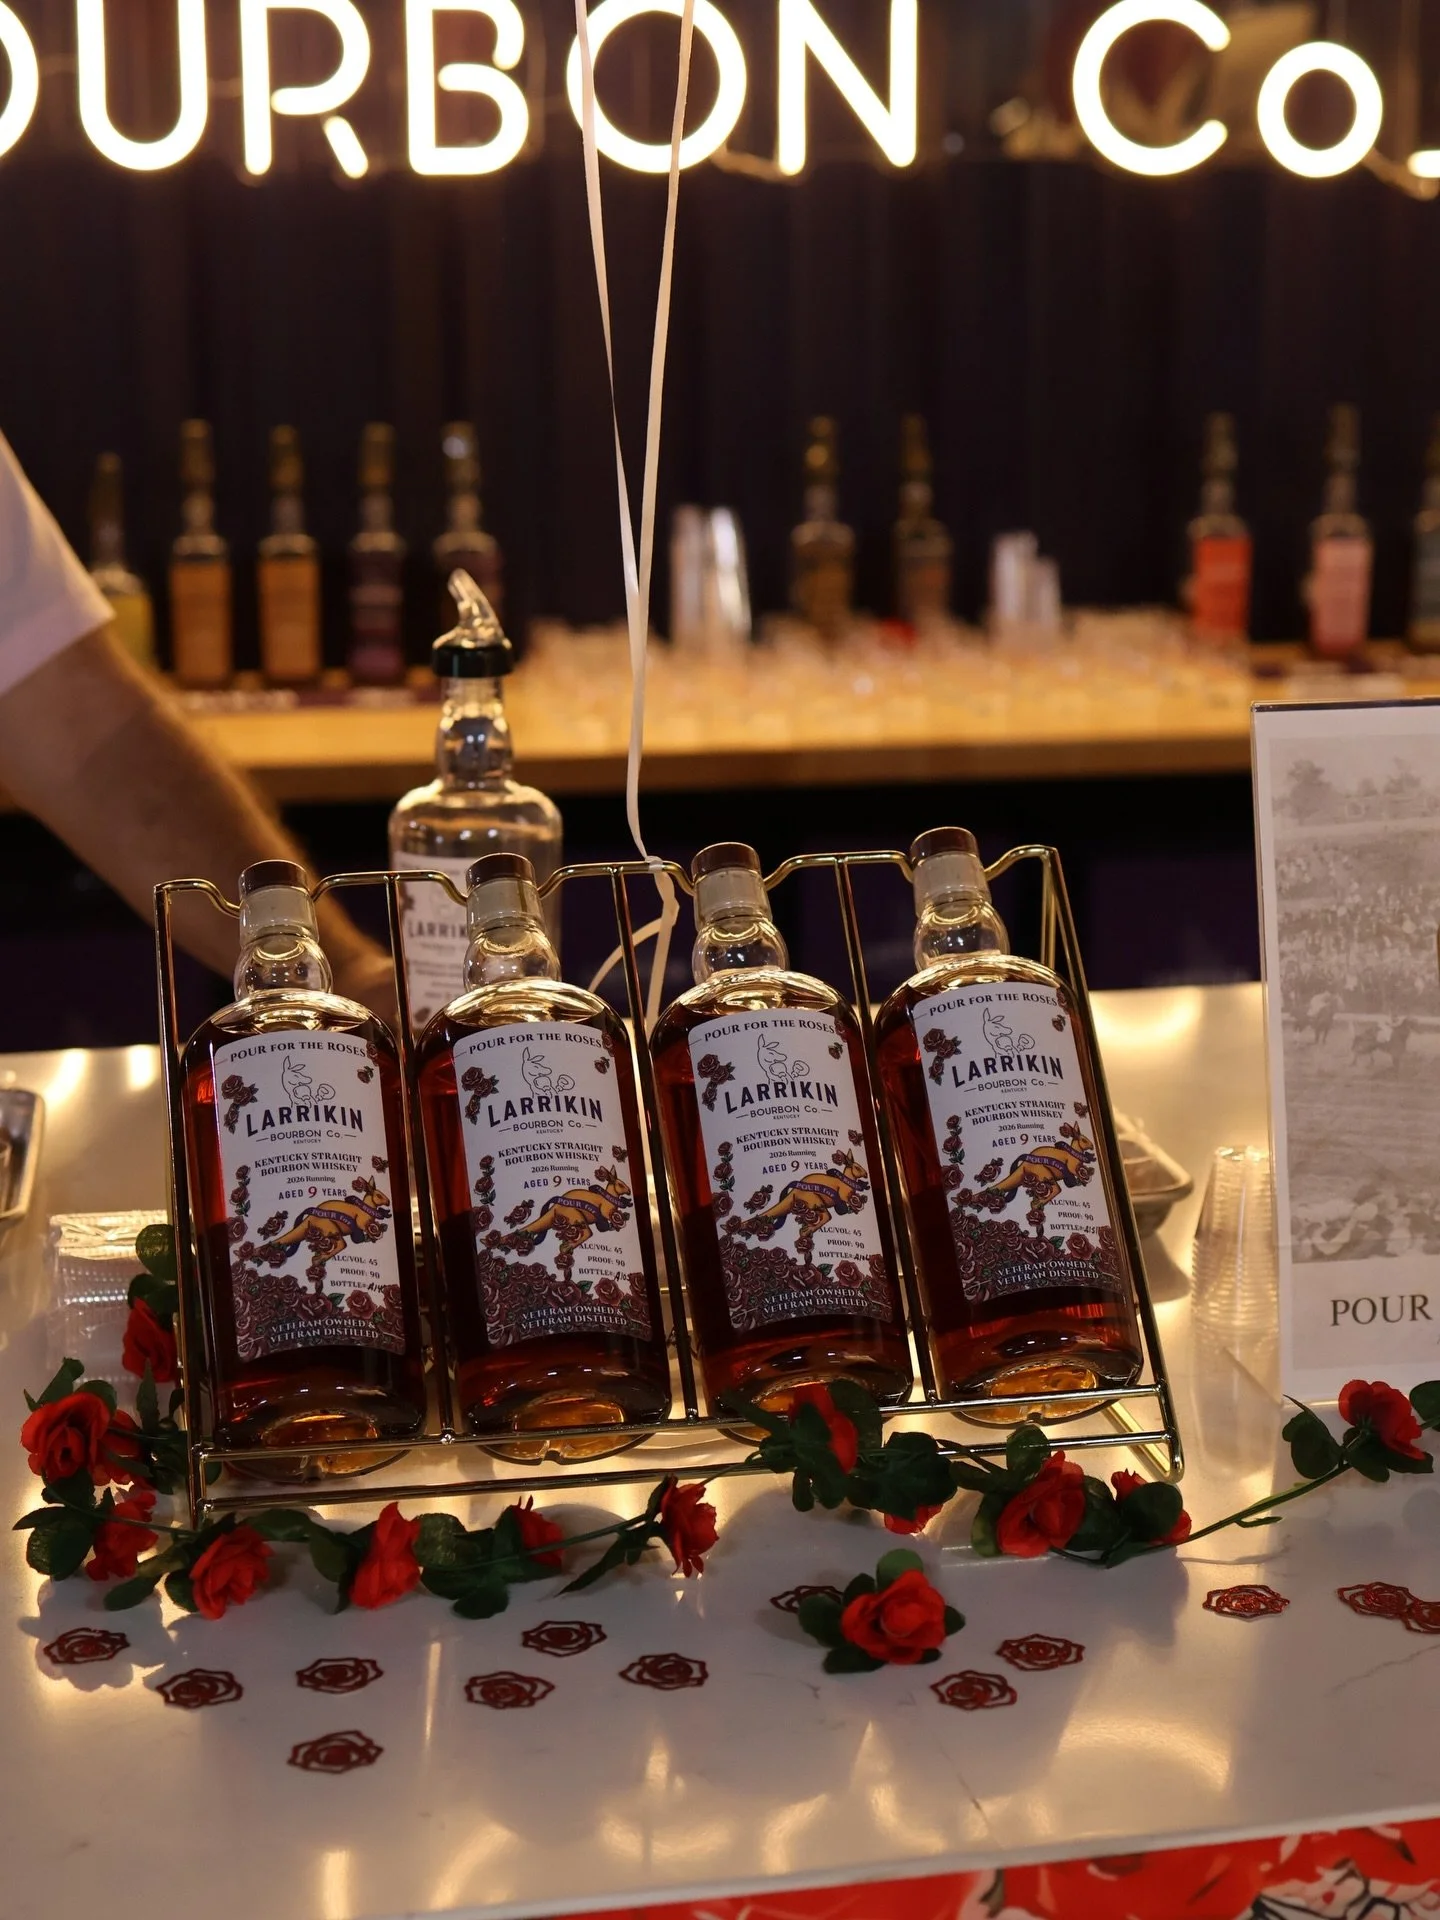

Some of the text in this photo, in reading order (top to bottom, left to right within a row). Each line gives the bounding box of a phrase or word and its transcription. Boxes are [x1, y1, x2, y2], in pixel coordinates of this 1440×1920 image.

[0, 0, 918, 178] URBON
[929, 993, 1057, 1017] POUR FOR THE ROSES
[704, 1019, 835, 1042] POUR FOR THE ROSES
[469, 1033, 602, 1054] POUR FOR THE ROSES
[230, 1042, 366, 1062] POUR FOR THE ROSES
[951, 1054, 1064, 1088] LARRIKIN
[977, 1079, 1047, 1092] BOURBON Co.
[725, 1081, 838, 1114] LARRIKIN
[488, 1095, 603, 1128] LARRIKIN
[750, 1105, 820, 1118] BOURBON Co.
[965, 1100, 1066, 1118] KENTUCKY STRAIGHT
[246, 1105, 363, 1137] LARRIKIN
[972, 1109, 1063, 1126] BOURBON WHISKEY
[513, 1120, 583, 1132] BOURBON Co.
[998, 1122, 1045, 1132] 2026 Running
[270, 1129, 343, 1142] BOURBON Co.
[736, 1127, 839, 1144] KENTUCKY STRAIGHT
[992, 1133, 1057, 1148] AGED 9 YEARS
[498, 1142, 603, 1158] KENTUCKY STRAIGHT
[743, 1136, 837, 1152] BOURBON WHISKEY
[254, 1152, 362, 1168] KENTUCKY STRAIGHT
[504, 1151, 600, 1167] BOURBON WHISKEY
[769, 1151, 788, 1159] 2026
[1025, 1155, 1049, 1165] POUR
[261, 1162, 358, 1177] BOURBON WHISKEY
[762, 1160, 829, 1175] AGED 9 YEARS
[287, 1176, 305, 1184] 2026
[523, 1175, 591, 1189] AGED 9 YEARS
[795, 1183, 820, 1192] POUR
[278, 1186, 347, 1200] AGED 9 YEARS
[557, 1197, 582, 1208] POUR
[312, 1209, 337, 1219] POUR
[1058, 1211, 1083, 1219] PROOF:
[827, 1239, 865, 1249] PROOF: 90
[368, 1258, 378, 1266] 45
[588, 1256, 625, 1267] PROOF: 90
[997, 1260, 1046, 1277] VETERAN
[1050, 1260, 1087, 1270] OWNED
[340, 1268, 380, 1279] PROOF: 90
[997, 1270, 1099, 1286] VETERAN DISTILLED
[764, 1289, 865, 1304] VETERAN OWNED &
[522, 1305, 624, 1320] VETERAN OWNED &
[763, 1298, 868, 1313] VETERAN DISTILLED
[1330, 1294, 1433, 1327] POUR
[271, 1318, 376, 1333] VETERAN OWNED &
[521, 1315, 627, 1330] VETERAN DISTILLED
[270, 1328, 379, 1343] VETERAN DISTILLED
